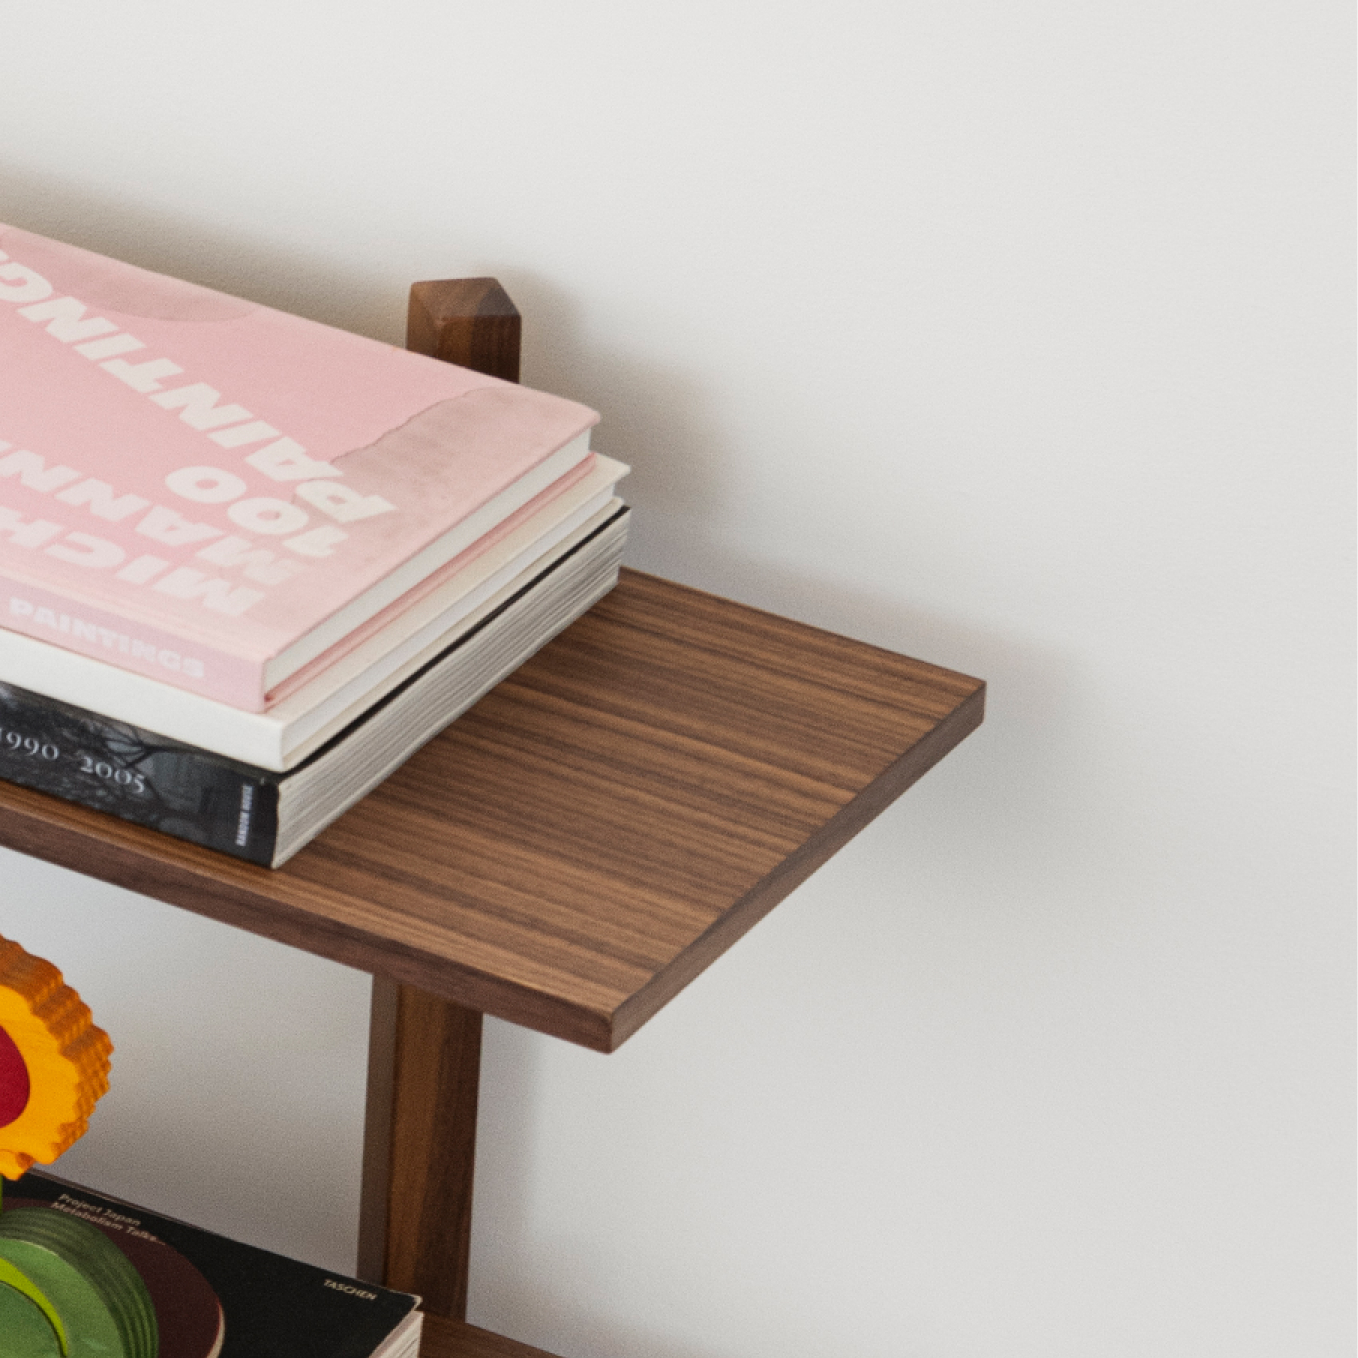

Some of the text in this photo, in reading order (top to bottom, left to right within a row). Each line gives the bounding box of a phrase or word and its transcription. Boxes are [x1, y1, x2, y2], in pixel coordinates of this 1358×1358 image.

[164, 465, 350, 557] 100
[9, 596, 207, 680] PAINTINGS
[79, 755, 147, 795] 2005
[58, 1193, 103, 1213] Project
[324, 1279, 378, 1300] TASCHEN
